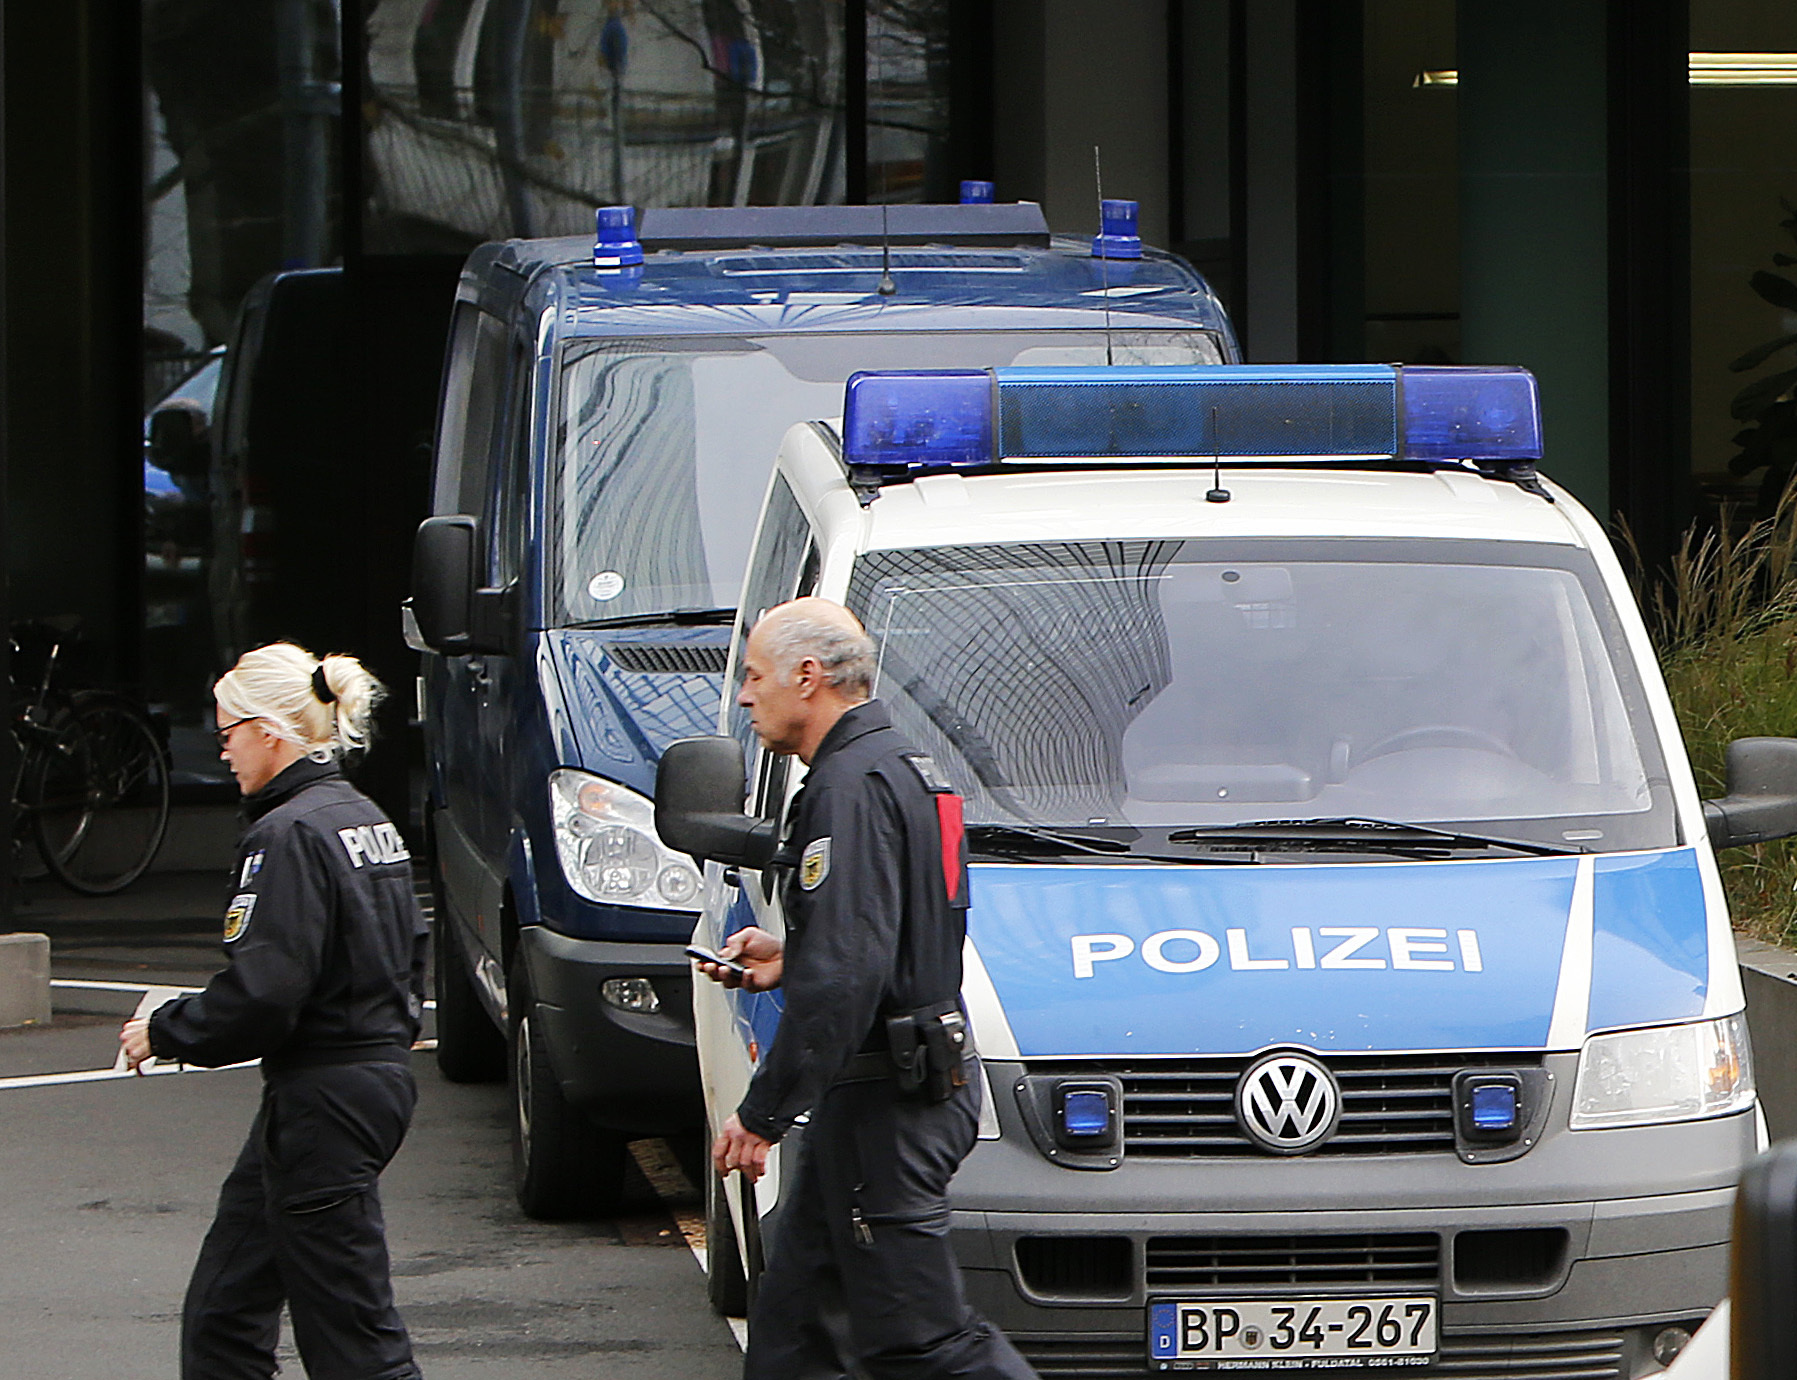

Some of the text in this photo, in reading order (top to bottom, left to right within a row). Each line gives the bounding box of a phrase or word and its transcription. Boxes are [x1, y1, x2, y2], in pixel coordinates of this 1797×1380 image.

[1071, 926, 1483, 979] POLIZEI
[1250, 1062, 1328, 1142] VW
[1160, 1335, 1171, 1349] D
[1180, 1302, 1432, 1352] BP 34-267
